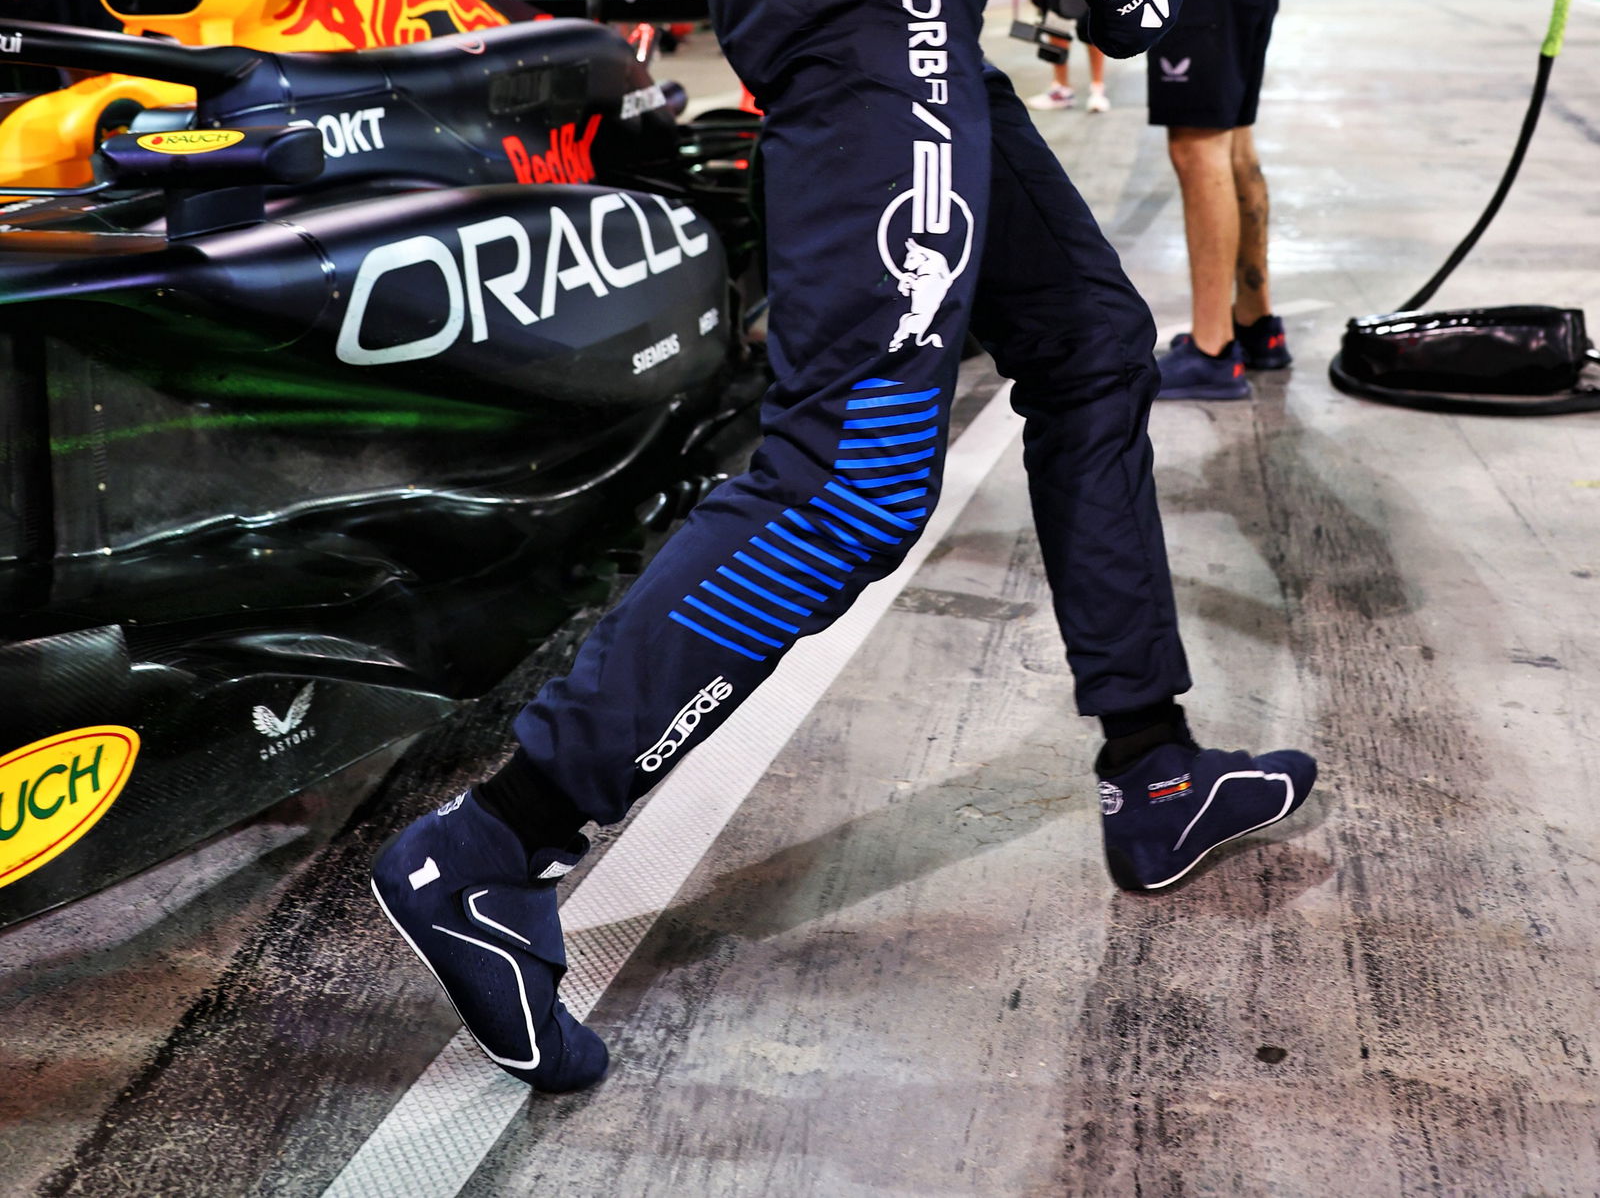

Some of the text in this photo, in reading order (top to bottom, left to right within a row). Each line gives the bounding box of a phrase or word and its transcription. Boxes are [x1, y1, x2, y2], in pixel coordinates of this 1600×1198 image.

[0, 32, 23, 53] ui
[165, 132, 231, 145] RAUCH
[288, 107, 385, 158] OKT
[335, 191, 710, 366] ORACLE
[259, 726, 317, 762] CASTORE
[635, 675, 734, 773] sparco
[0, 744, 104, 842] UCH
